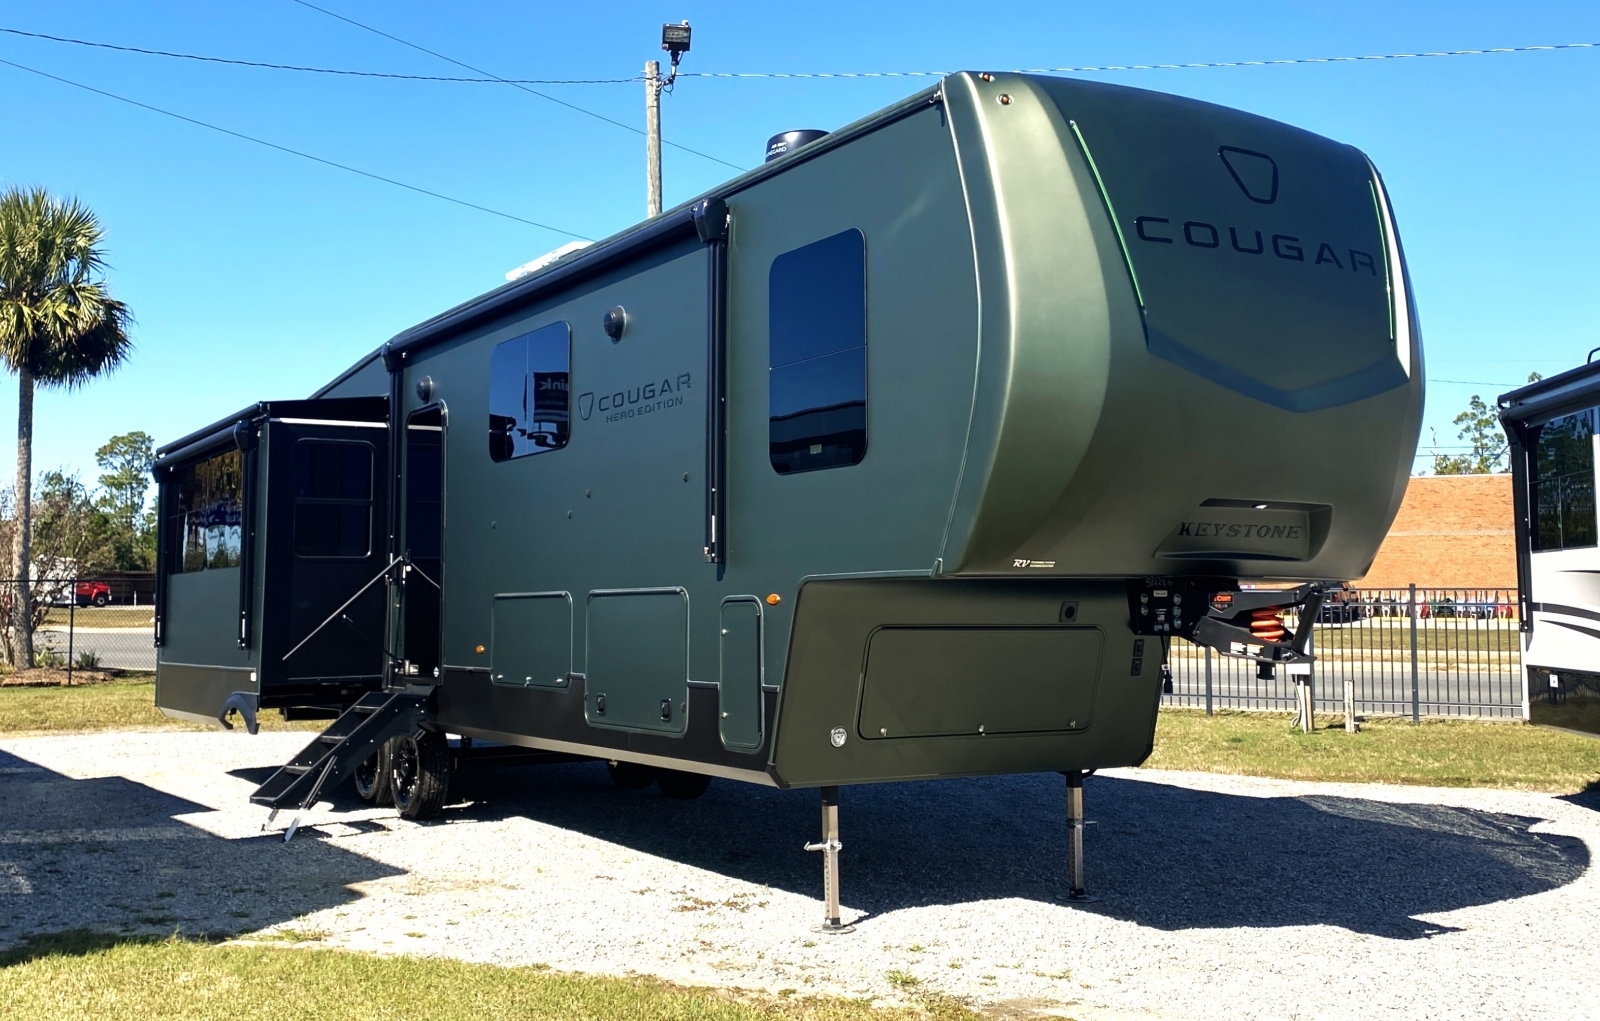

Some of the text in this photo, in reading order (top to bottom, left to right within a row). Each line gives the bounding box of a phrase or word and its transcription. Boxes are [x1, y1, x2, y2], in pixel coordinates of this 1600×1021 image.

[1135, 215, 1378, 277] COUGAR
[598, 372, 691, 412] COUGAR
[605, 395, 683, 424] HERO EDITION
[1177, 521, 1303, 539] KEYSTONE
[1013, 558, 1031, 568] RV
